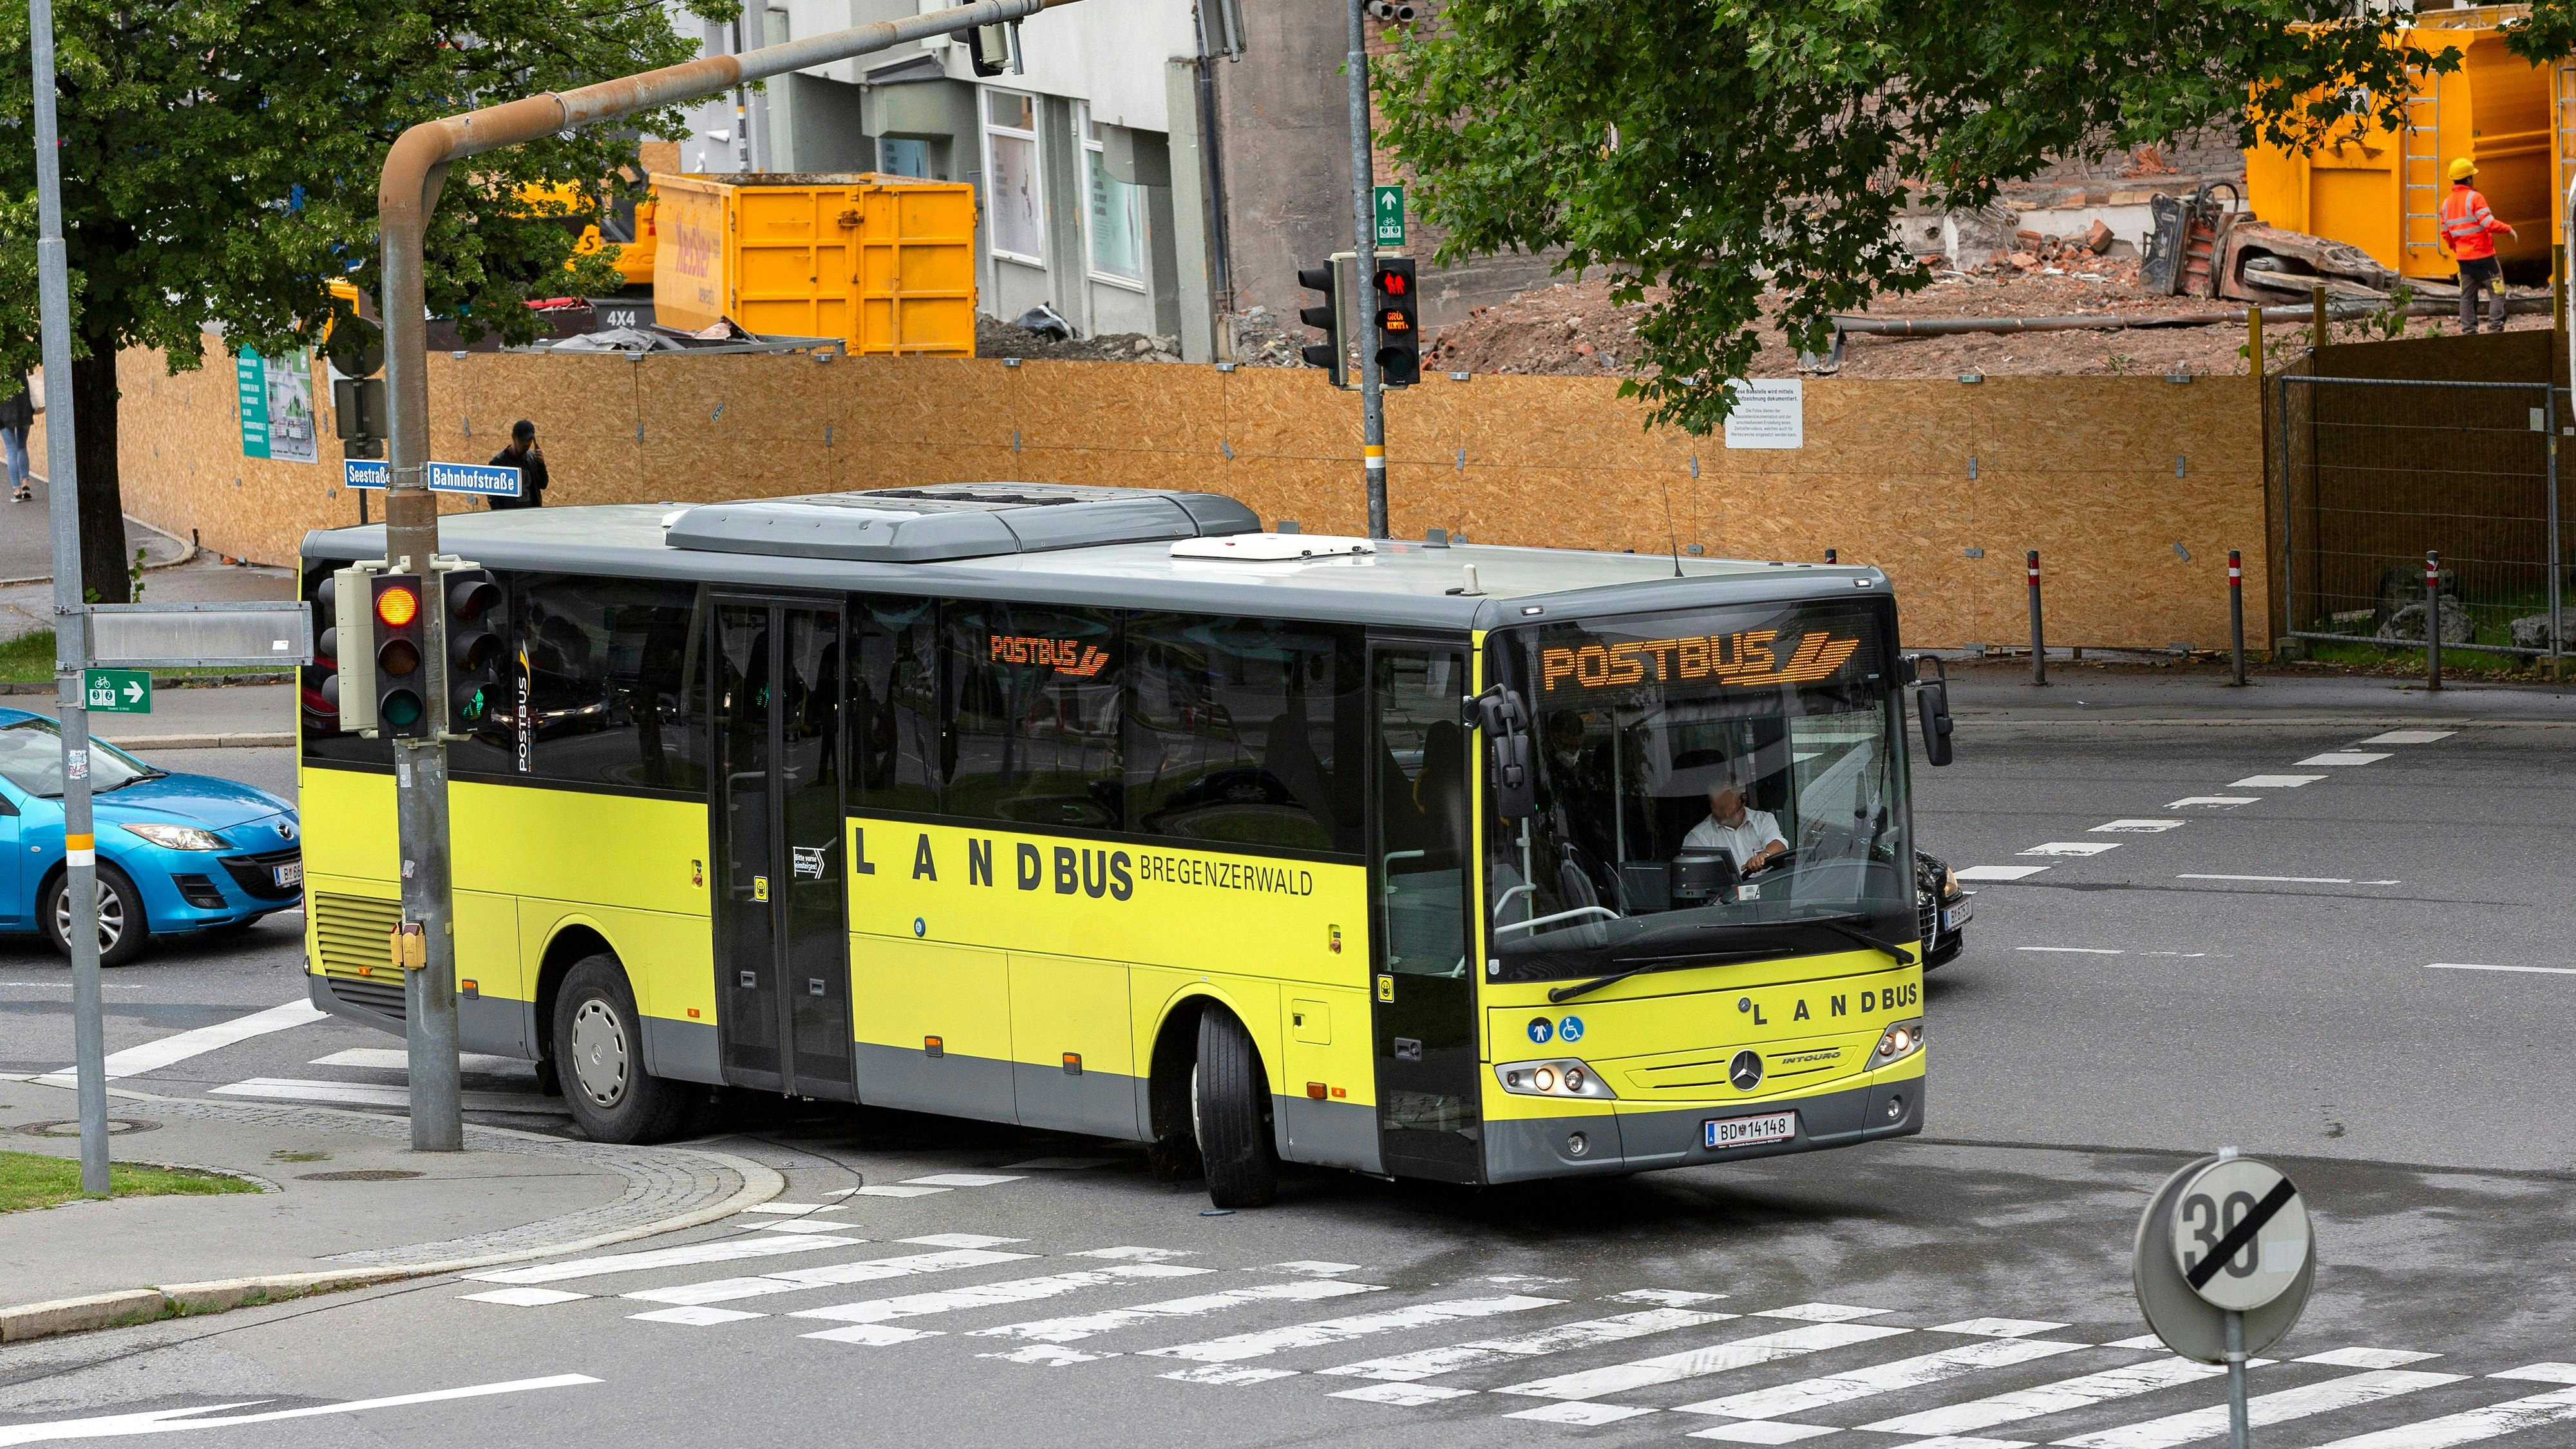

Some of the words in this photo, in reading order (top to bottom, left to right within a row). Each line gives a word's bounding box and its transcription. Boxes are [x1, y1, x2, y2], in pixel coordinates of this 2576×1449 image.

[607, 310, 636, 326] 4X4
[433, 468, 515, 491] Bahnhofstraße
[991, 635, 1078, 666] POSTBUS
[1543, 630, 1777, 690] POSTBUS
[518, 676, 527, 772] POSTBUS
[1141, 855, 1313, 896] BREGENZERWALD
[1781, 1051, 1841, 1065] INTOURO
[2183, 1191, 2259, 1279] 30
